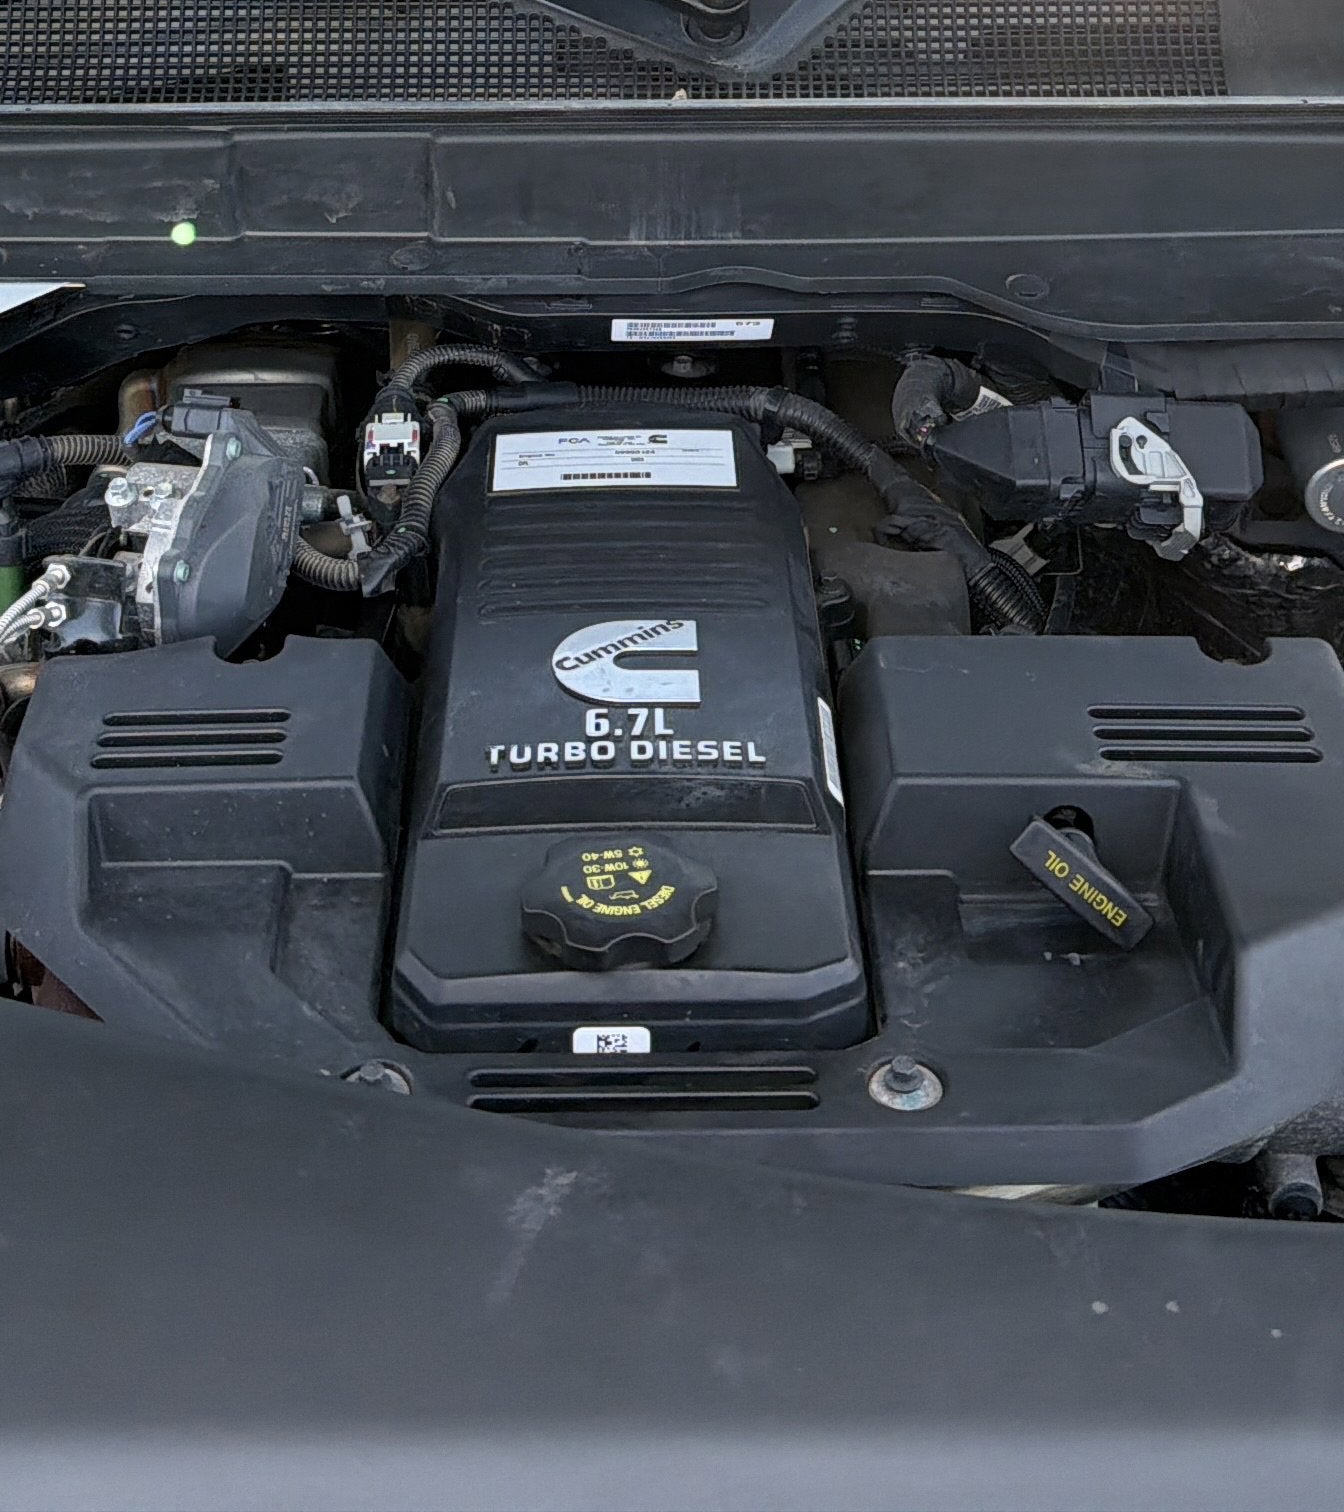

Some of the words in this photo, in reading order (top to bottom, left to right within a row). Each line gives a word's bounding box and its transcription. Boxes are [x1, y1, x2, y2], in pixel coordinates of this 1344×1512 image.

[555, 620, 685, 672] Cummins
[585, 708, 674, 737] 6.7L
[488, 740, 616, 767] TURBO
[629, 739, 767, 764] DIESEL
[581, 849, 623, 862] 5W-40
[582, 861, 630, 874] 10W-30
[1043, 849, 1070, 878] OIL
[575, 893, 596, 909] OIL
[592, 902, 642, 916] ENGINE
[639, 884, 676, 912] DIESEL
[1068, 873, 1128, 928] ENGINE
